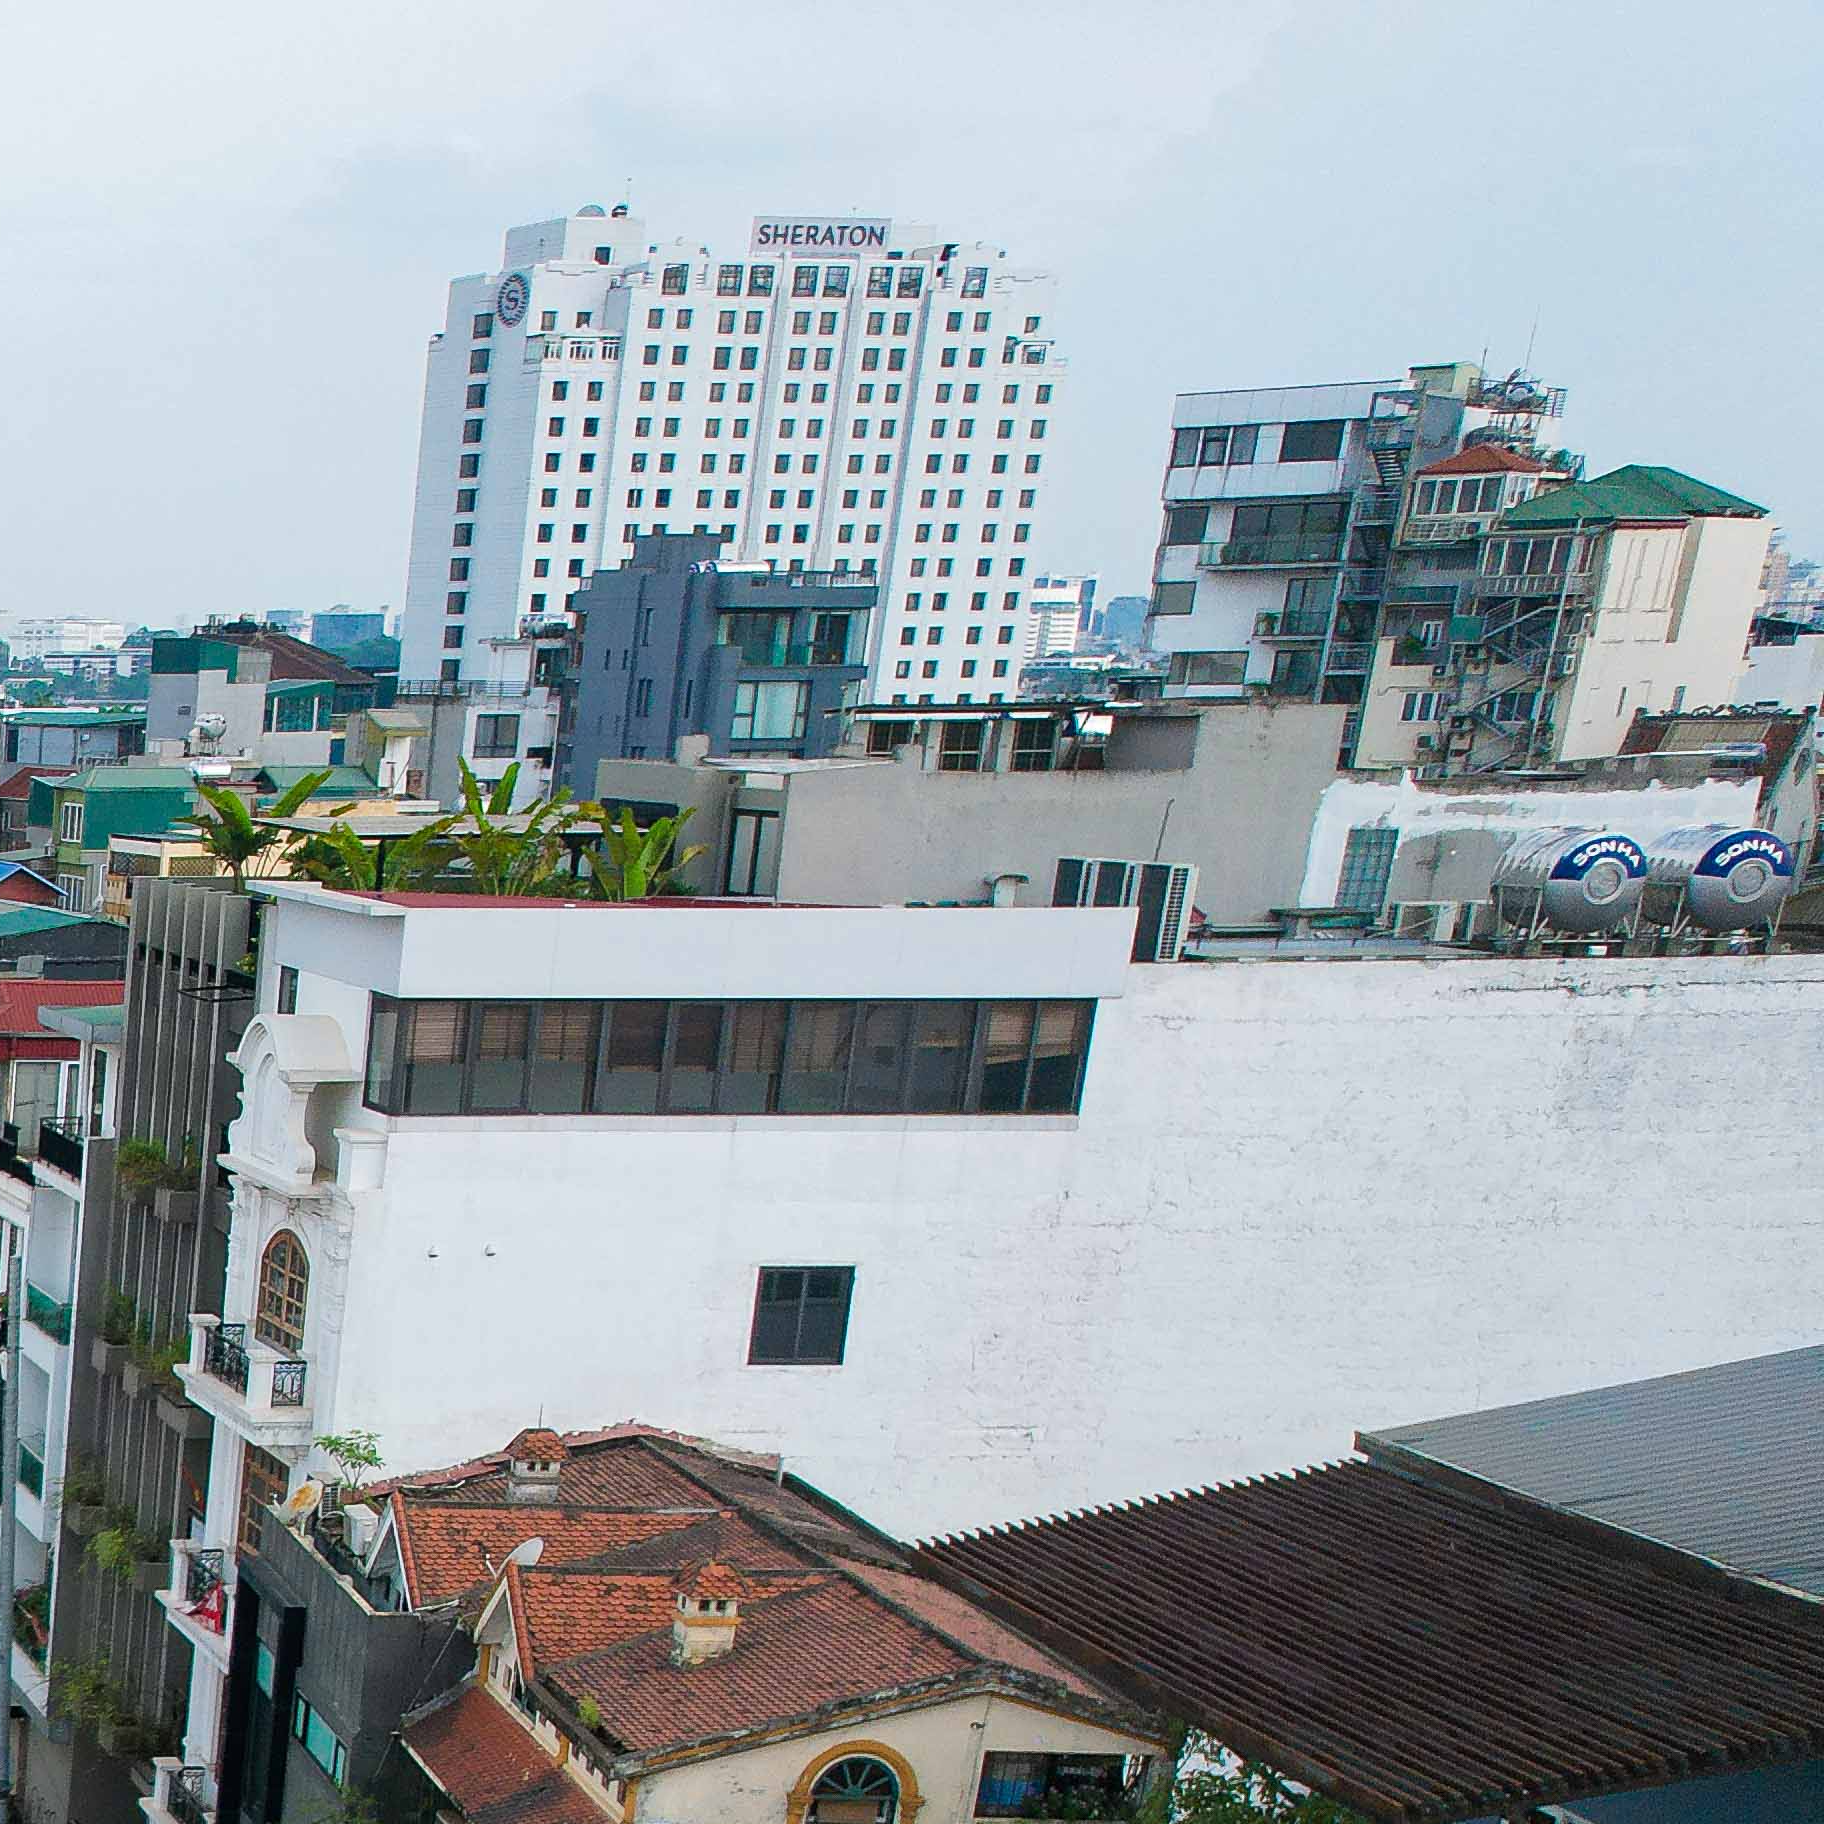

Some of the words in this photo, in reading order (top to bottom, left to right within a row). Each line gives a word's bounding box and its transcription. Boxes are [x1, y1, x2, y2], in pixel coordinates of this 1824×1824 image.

[757, 224, 885, 247] SHERATON
[1572, 838, 1641, 868] SONHA
[1715, 838, 1783, 868] SONHA
